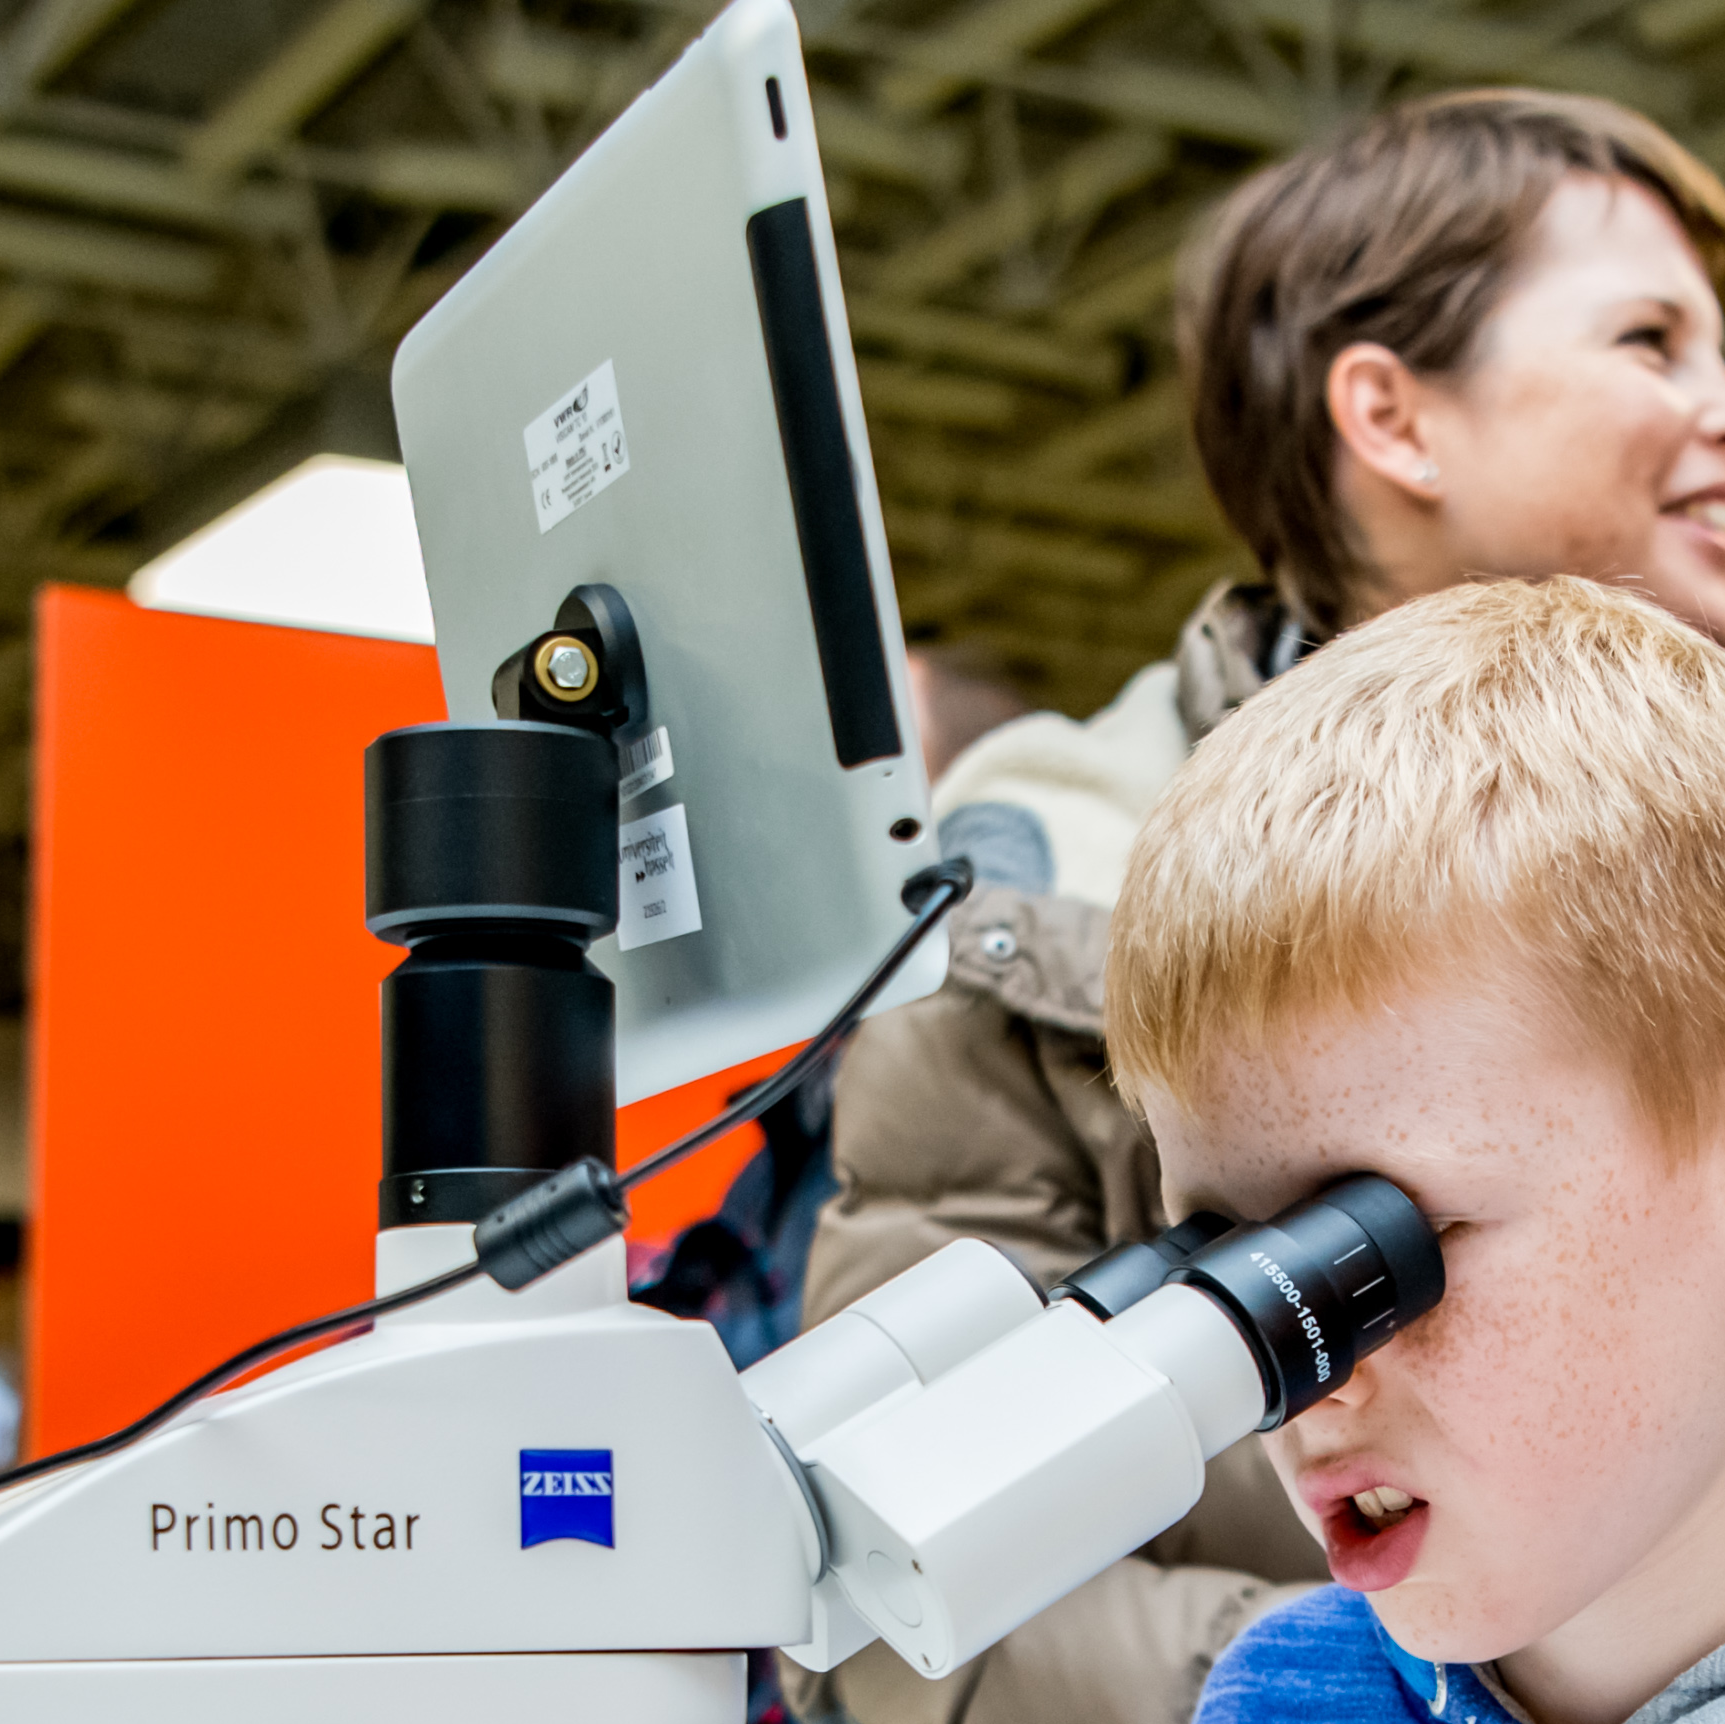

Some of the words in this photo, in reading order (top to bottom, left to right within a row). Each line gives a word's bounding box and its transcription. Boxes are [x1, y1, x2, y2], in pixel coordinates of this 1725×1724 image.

[1250, 1252, 1331, 1383] 415500-1501-000
[522, 1471, 613, 1497] ZEISS
[151, 1502, 300, 1551] Primo
[319, 1502, 421, 1551] Star
